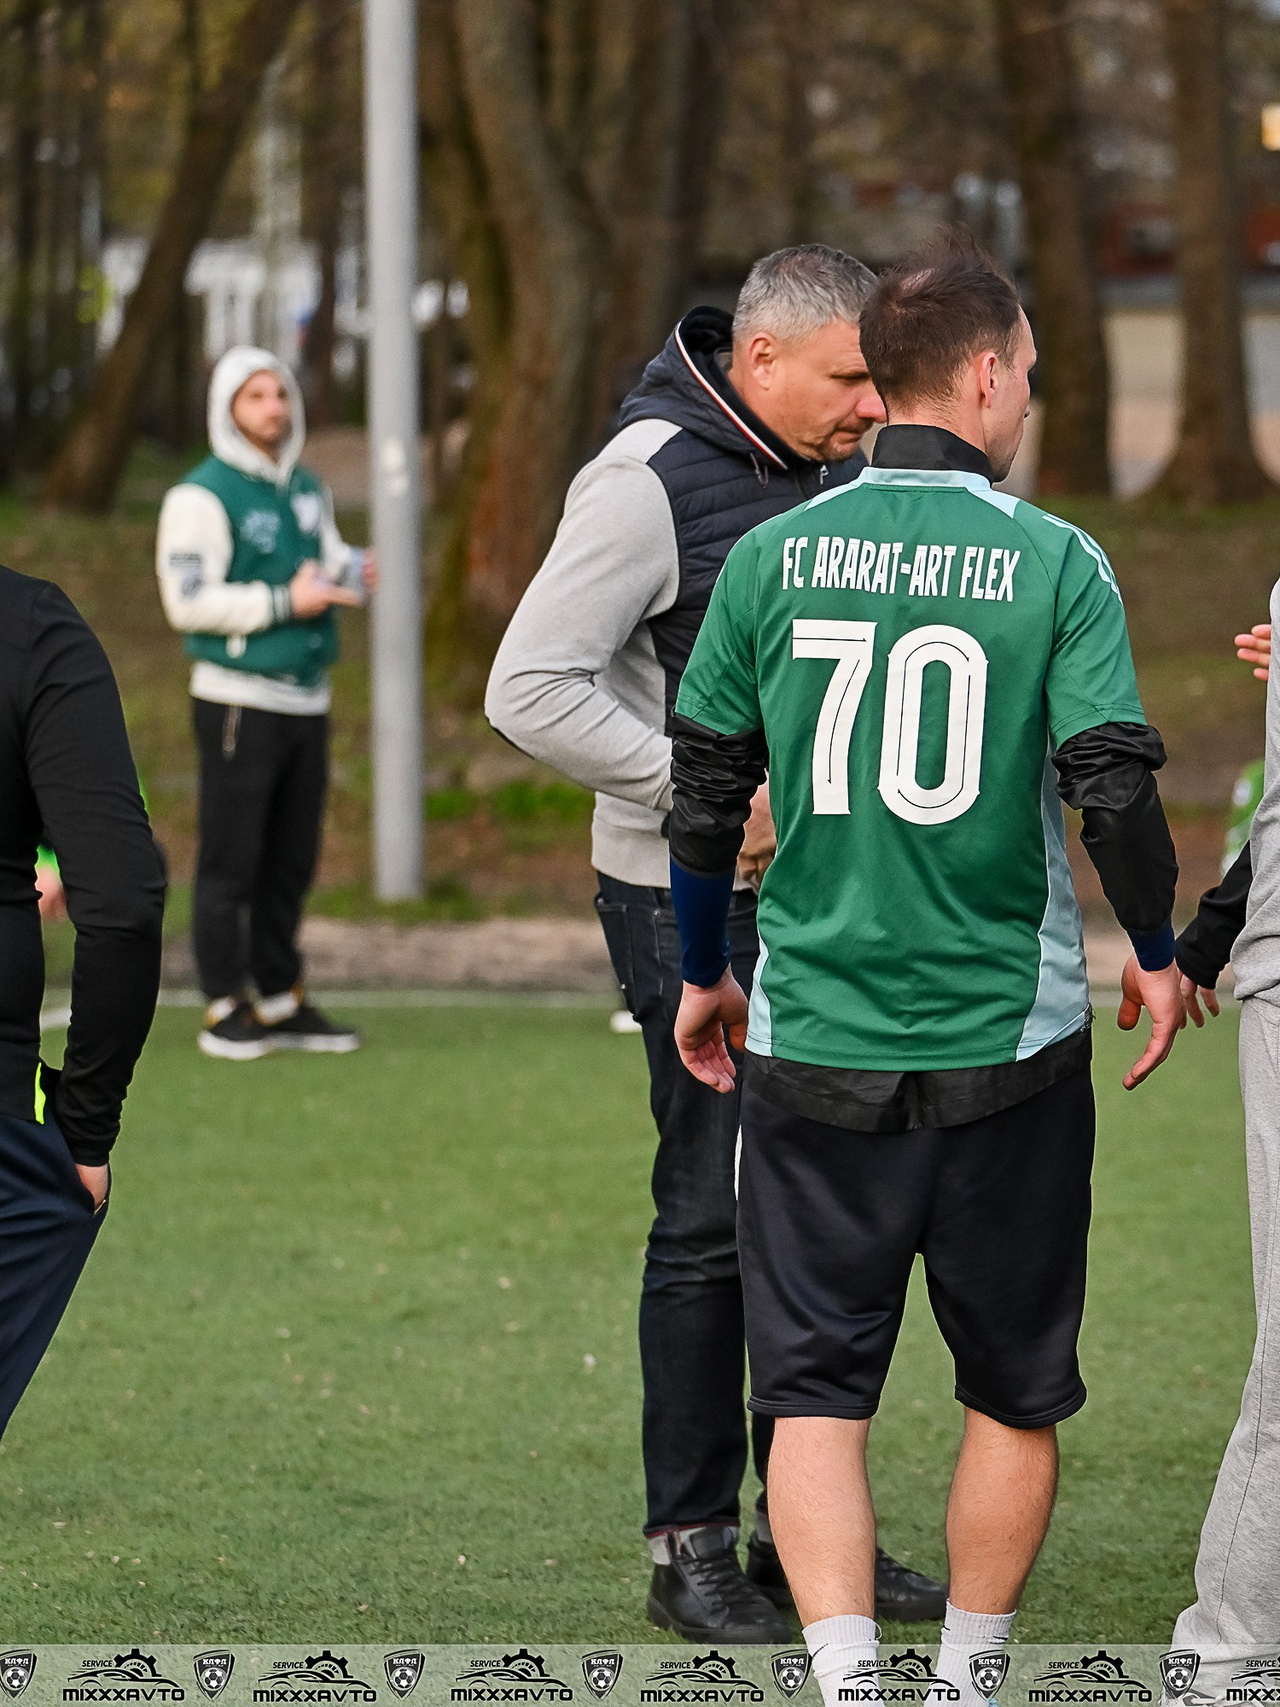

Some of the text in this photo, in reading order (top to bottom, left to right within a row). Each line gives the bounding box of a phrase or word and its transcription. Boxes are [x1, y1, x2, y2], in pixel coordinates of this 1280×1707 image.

[782, 536, 1021, 602] FC ARARAT-ART FLEX
[792, 618, 989, 826] 70
